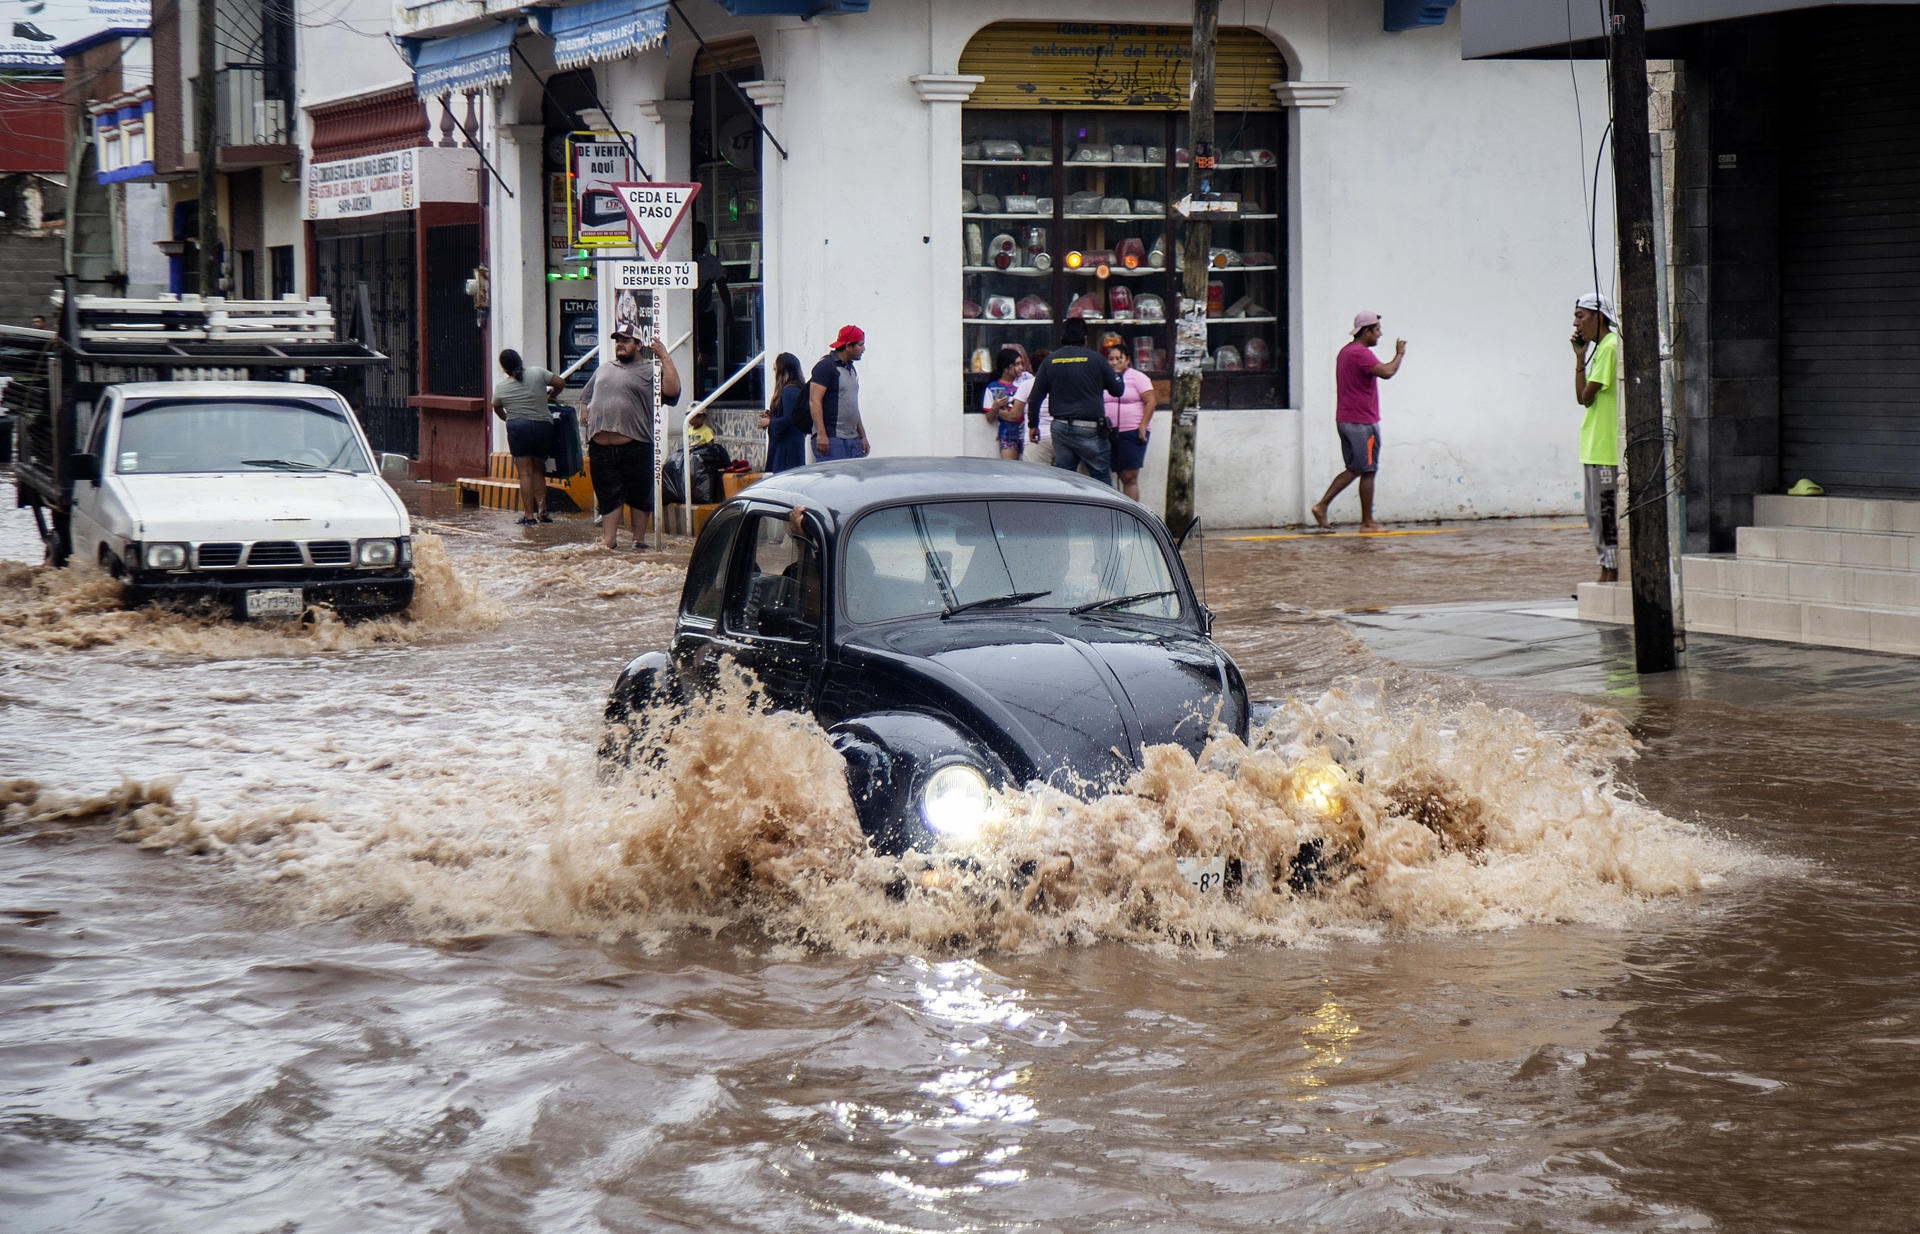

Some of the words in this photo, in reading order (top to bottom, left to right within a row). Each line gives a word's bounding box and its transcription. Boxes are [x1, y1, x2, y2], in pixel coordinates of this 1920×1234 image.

[1122, 42, 1147, 57] del
[1155, 43, 1192, 58] Futu
[579, 145, 590, 157] DE
[594, 145, 626, 157] VENTA
[591, 160, 614, 174] AQUÍ
[630, 191, 661, 203] CEDA
[666, 192, 682, 203] EL
[639, 206, 672, 218] PASO
[623, 265, 672, 275] PRIMERO
[675, 263, 690, 275] TÚ
[623, 277, 671, 285] DESPUES
[675, 277, 689, 285] YO
[564, 301, 584, 311] LTH
